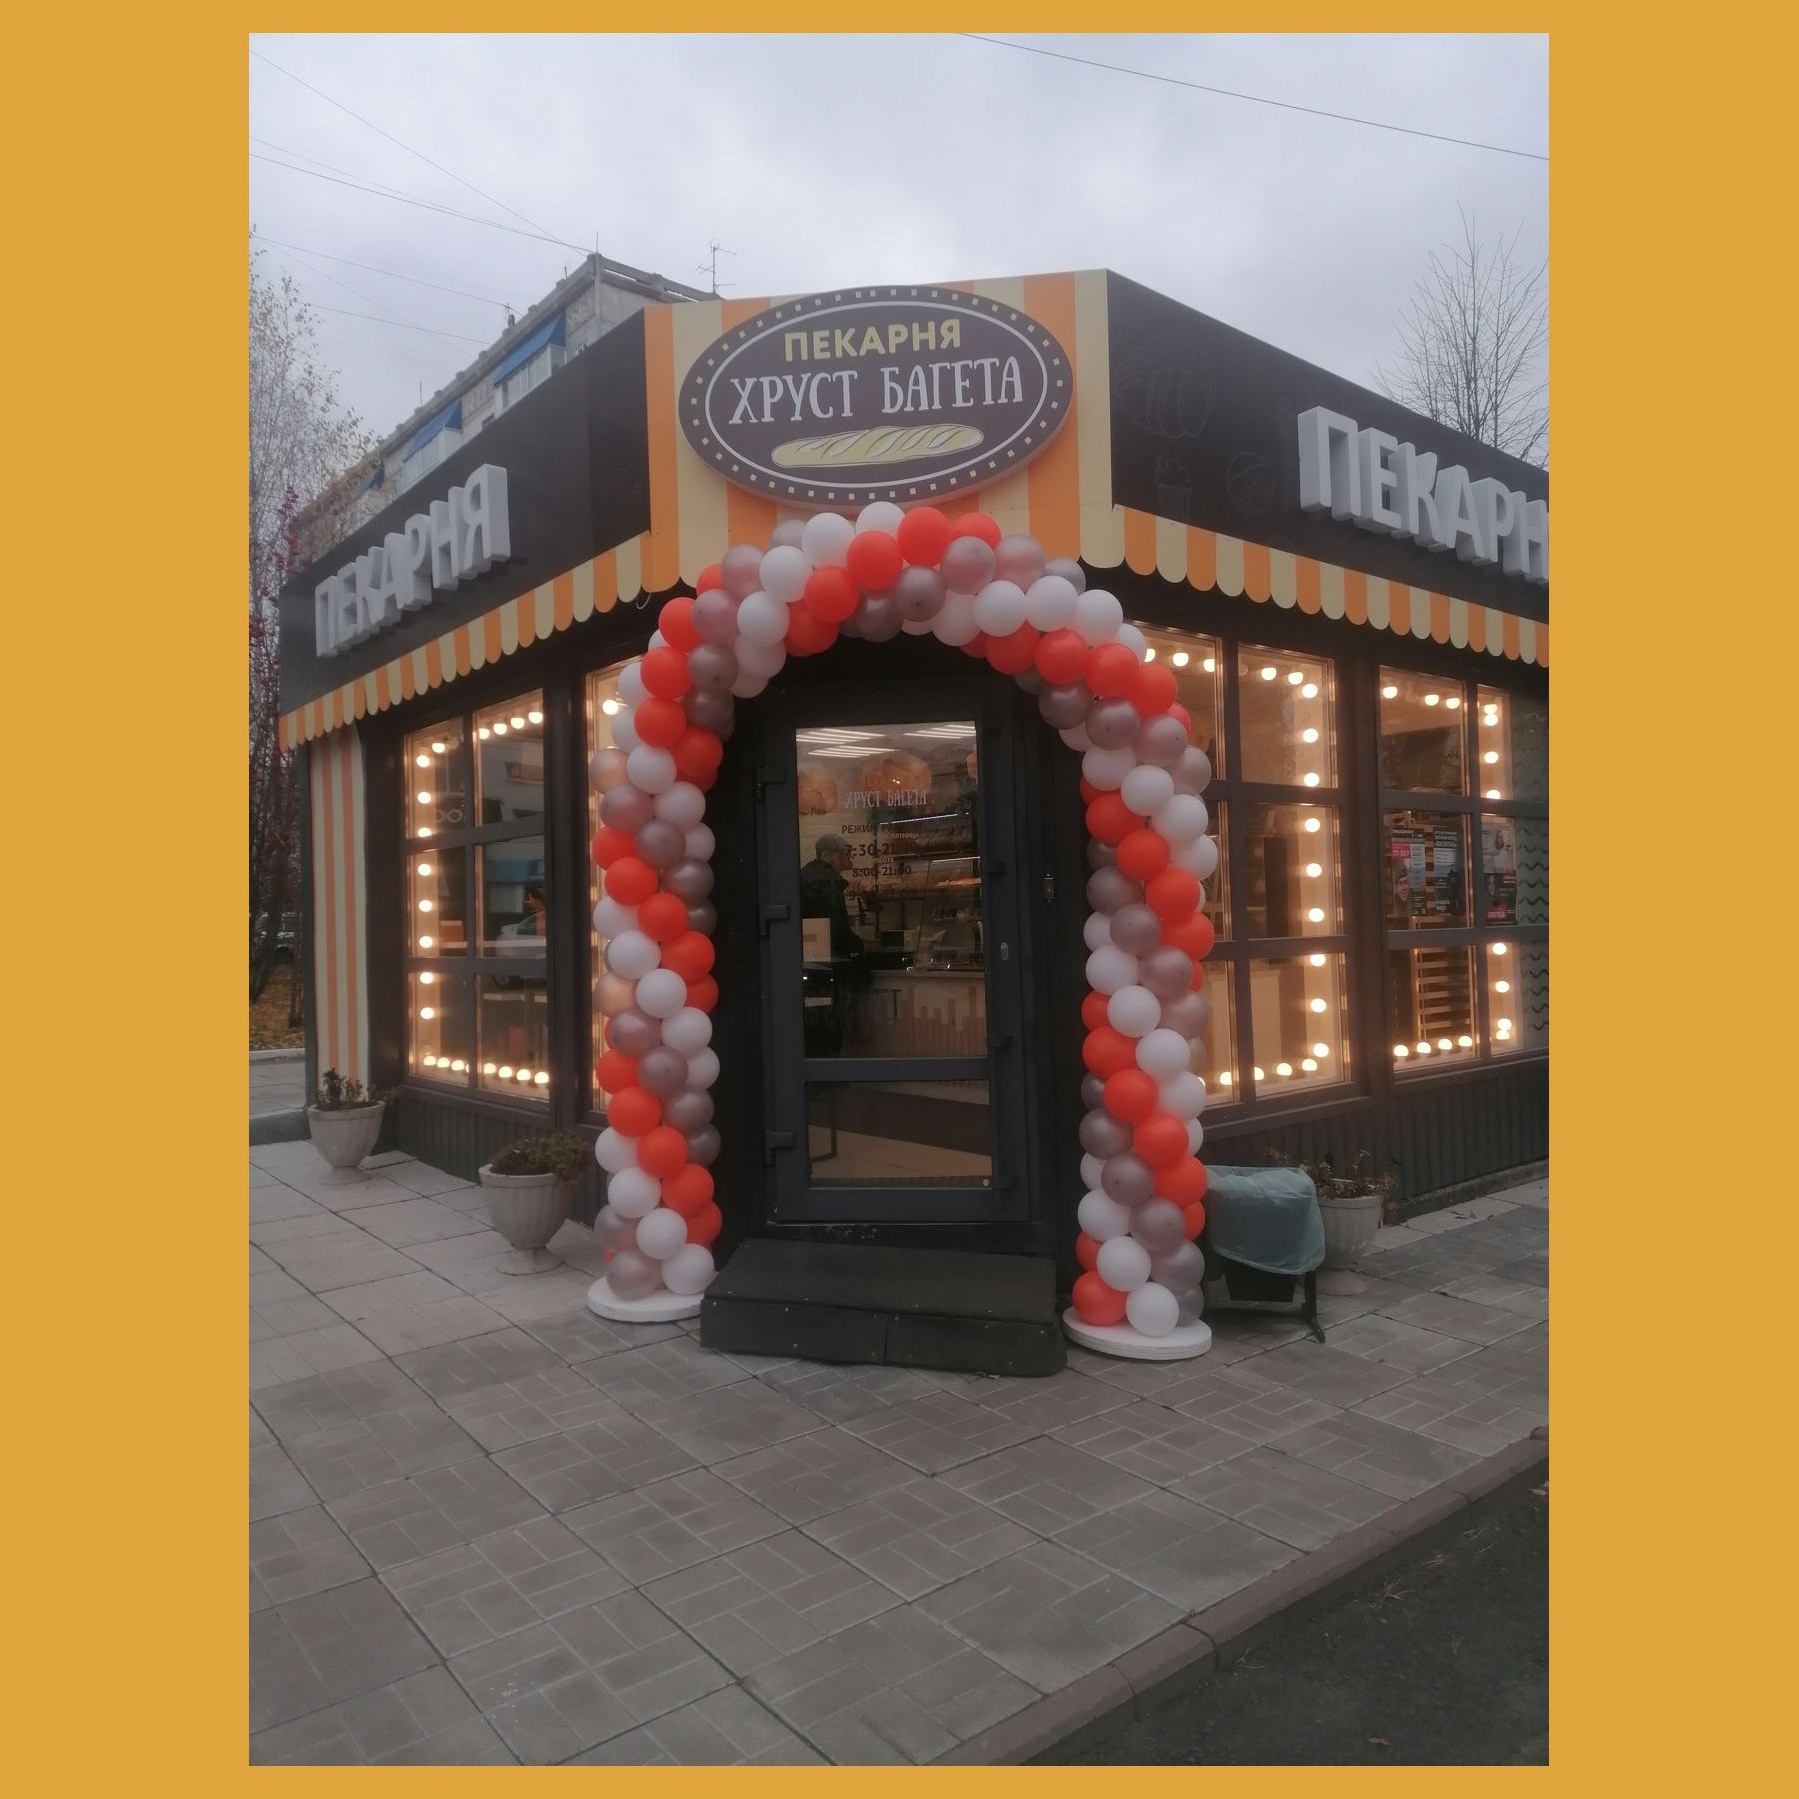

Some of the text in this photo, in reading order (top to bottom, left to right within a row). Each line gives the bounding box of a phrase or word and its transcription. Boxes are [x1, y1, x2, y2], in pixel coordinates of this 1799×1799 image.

[783, 318, 961, 363] ПЕКАРНЯ
[728, 356, 1024, 425] ХРУСТ БАГЕТА
[315, 463, 511, 657] ПЕКАРНЯ
[845, 789, 927, 808] ХРУСТ БАГЕТА
